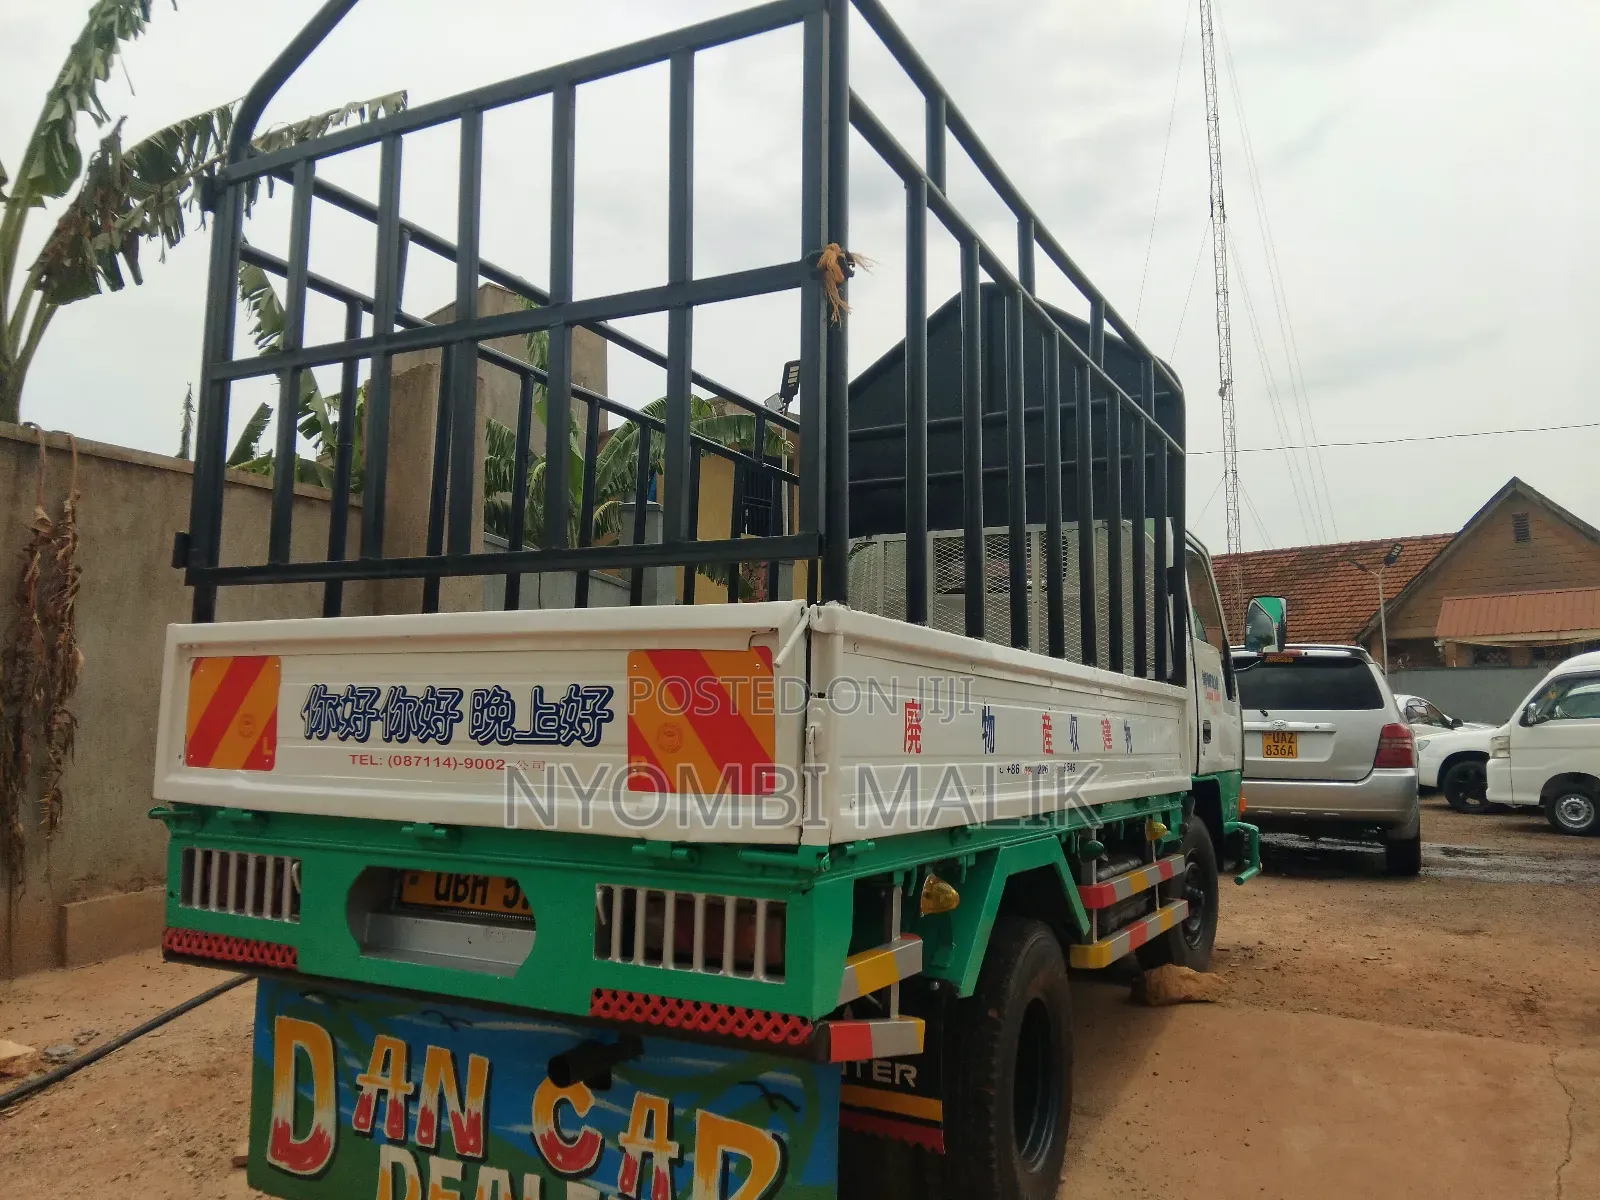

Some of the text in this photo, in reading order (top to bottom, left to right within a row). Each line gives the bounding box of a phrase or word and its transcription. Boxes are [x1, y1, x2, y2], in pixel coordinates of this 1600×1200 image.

[1265, 744, 1294, 757] 836A
[349, 754, 383, 767] TEL:
[266, 1015, 490, 1176] DAN
